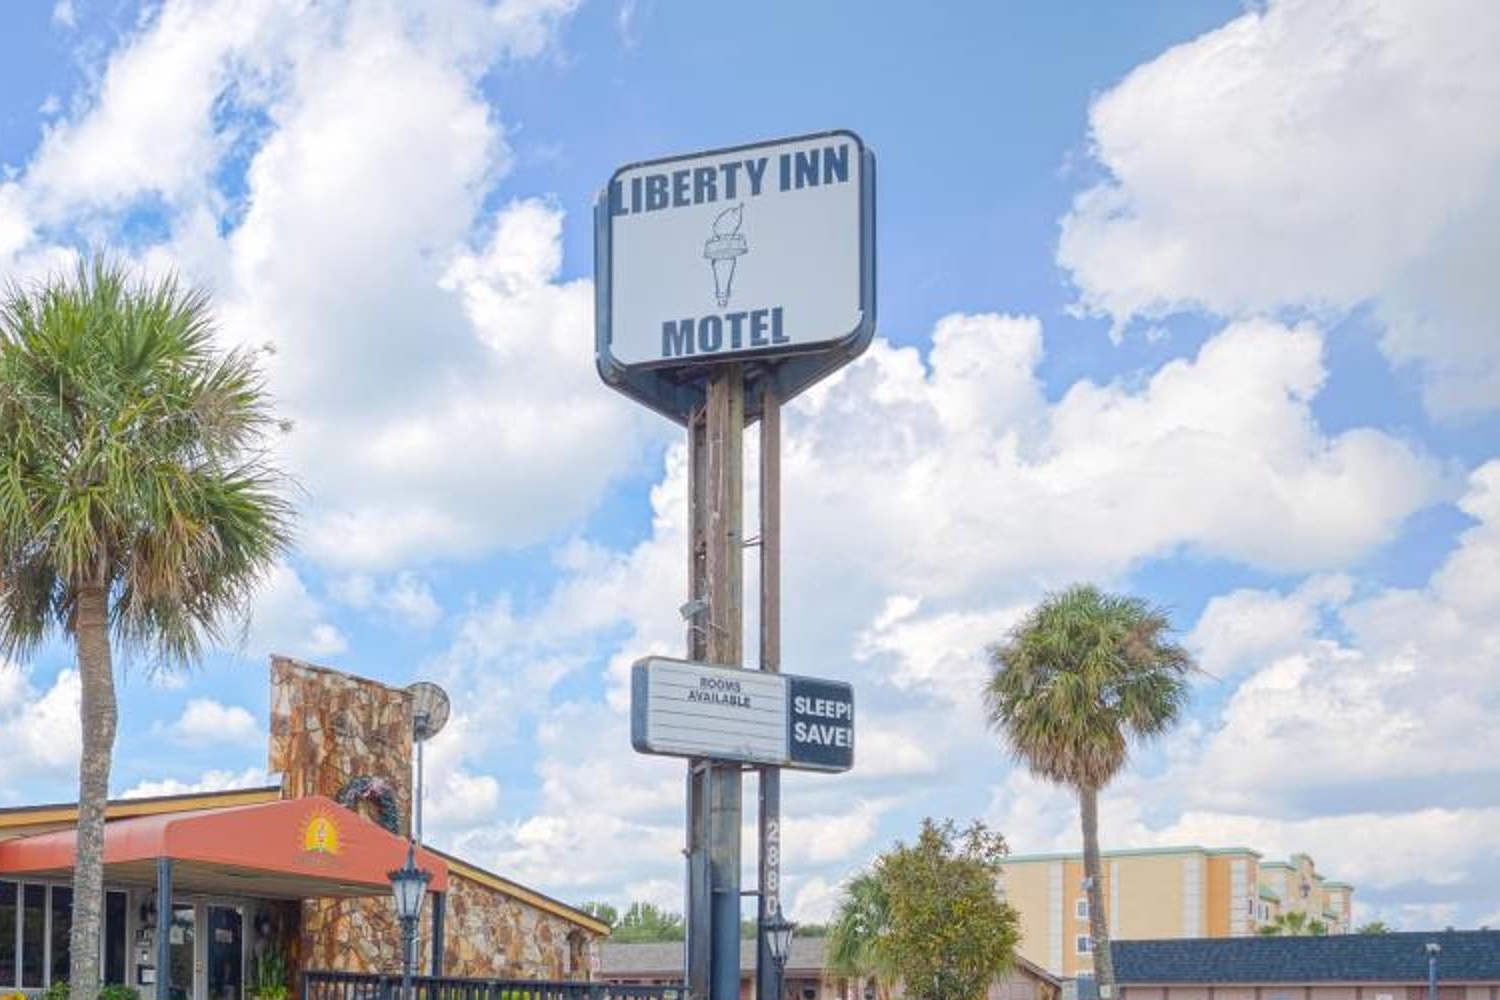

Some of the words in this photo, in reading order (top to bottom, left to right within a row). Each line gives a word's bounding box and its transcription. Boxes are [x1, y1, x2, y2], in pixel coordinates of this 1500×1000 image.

[611, 158, 768, 216] LIBERTY
[779, 145, 849, 192] INN
[662, 307, 790, 356] MOTEL
[688, 690, 751, 708] AVAILABLE
[700, 677, 741, 693] ROOMS
[767, 821, 779, 915] 2880
